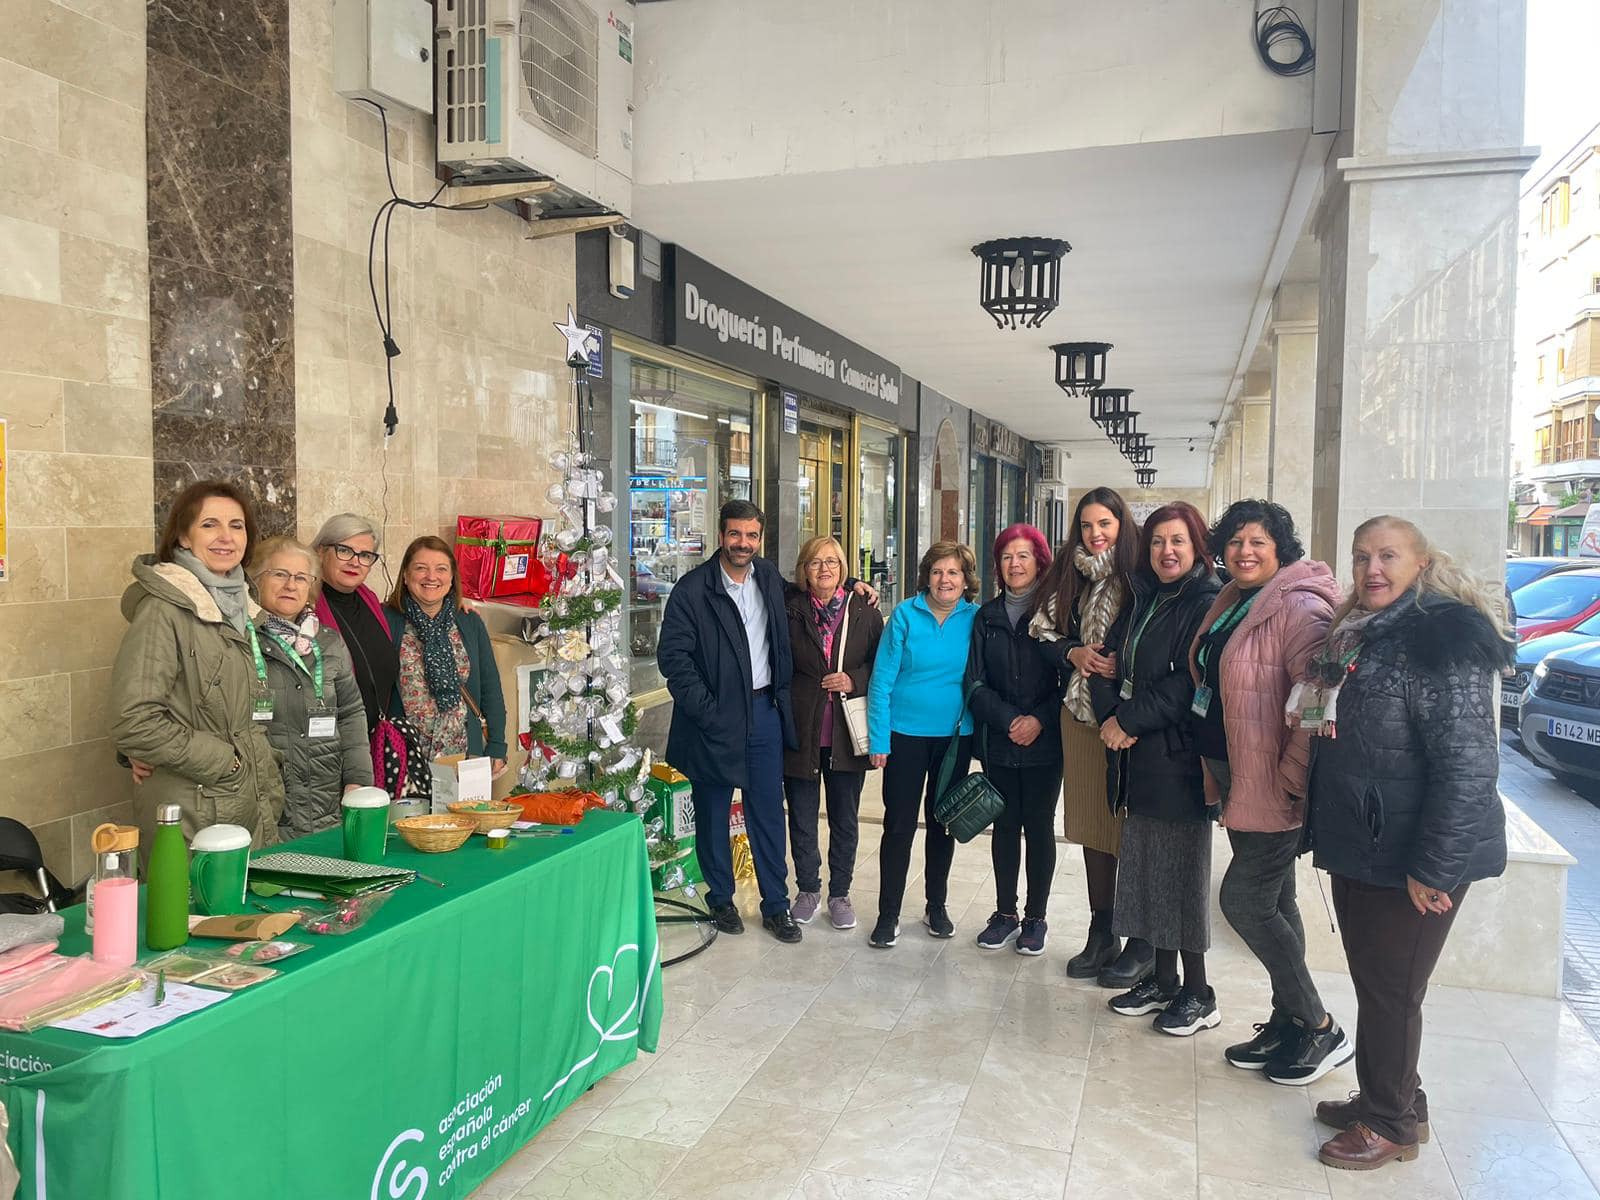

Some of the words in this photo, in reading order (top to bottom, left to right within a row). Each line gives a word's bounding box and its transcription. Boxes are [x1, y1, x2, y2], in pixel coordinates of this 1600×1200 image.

[1555, 721, 1584, 741] 6142
[439, 1074, 502, 1135] asociación
[439, 1104, 493, 1161] española
[439, 1142, 478, 1187] contra
[481, 1126, 491, 1151] el
[492, 1097, 532, 1139] cáncer
